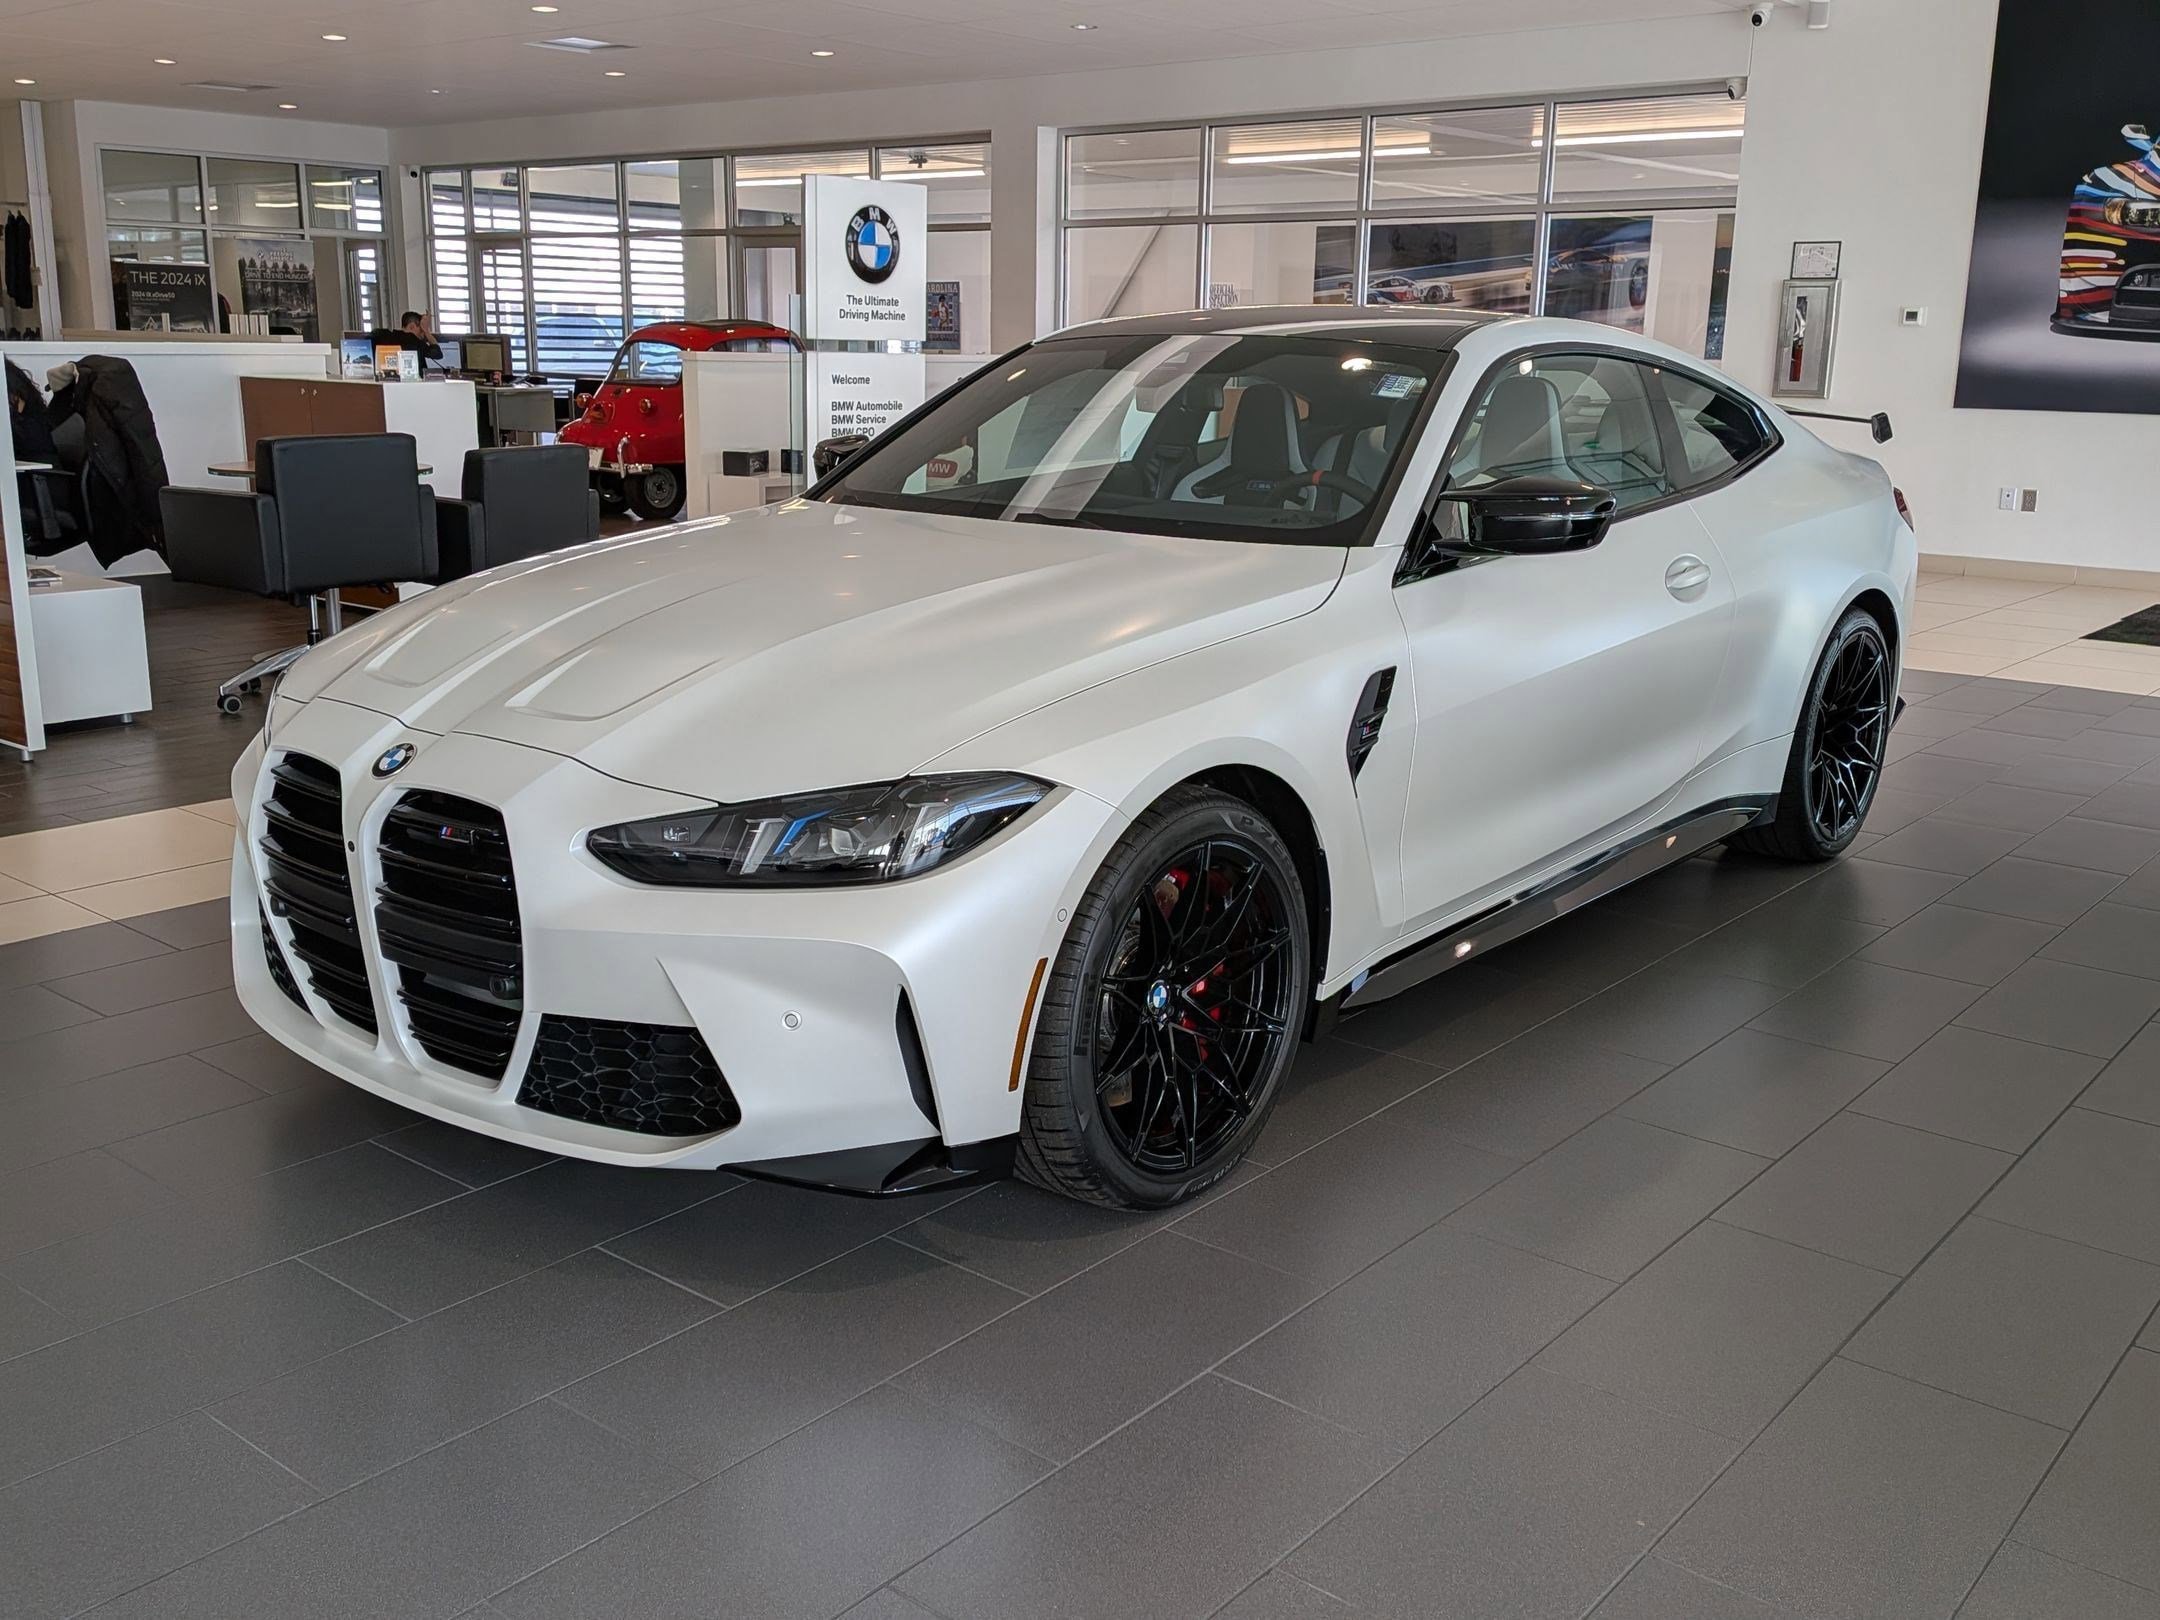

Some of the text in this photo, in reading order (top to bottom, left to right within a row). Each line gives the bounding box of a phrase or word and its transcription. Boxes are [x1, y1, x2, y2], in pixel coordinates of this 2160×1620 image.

[851, 207, 897, 234] BMW
[129, 271, 206, 287] THE 2024 iX
[846, 294, 900, 307] The Ultimate
[839, 308, 906, 321] Driving Machine
[831, 374, 871, 385] Welcome
[831, 400, 903, 411] BMW Automobile
[831, 413, 887, 425] BMW Service
[831, 427, 875, 437] BMW CPO
[928, 462, 951, 474] MW
